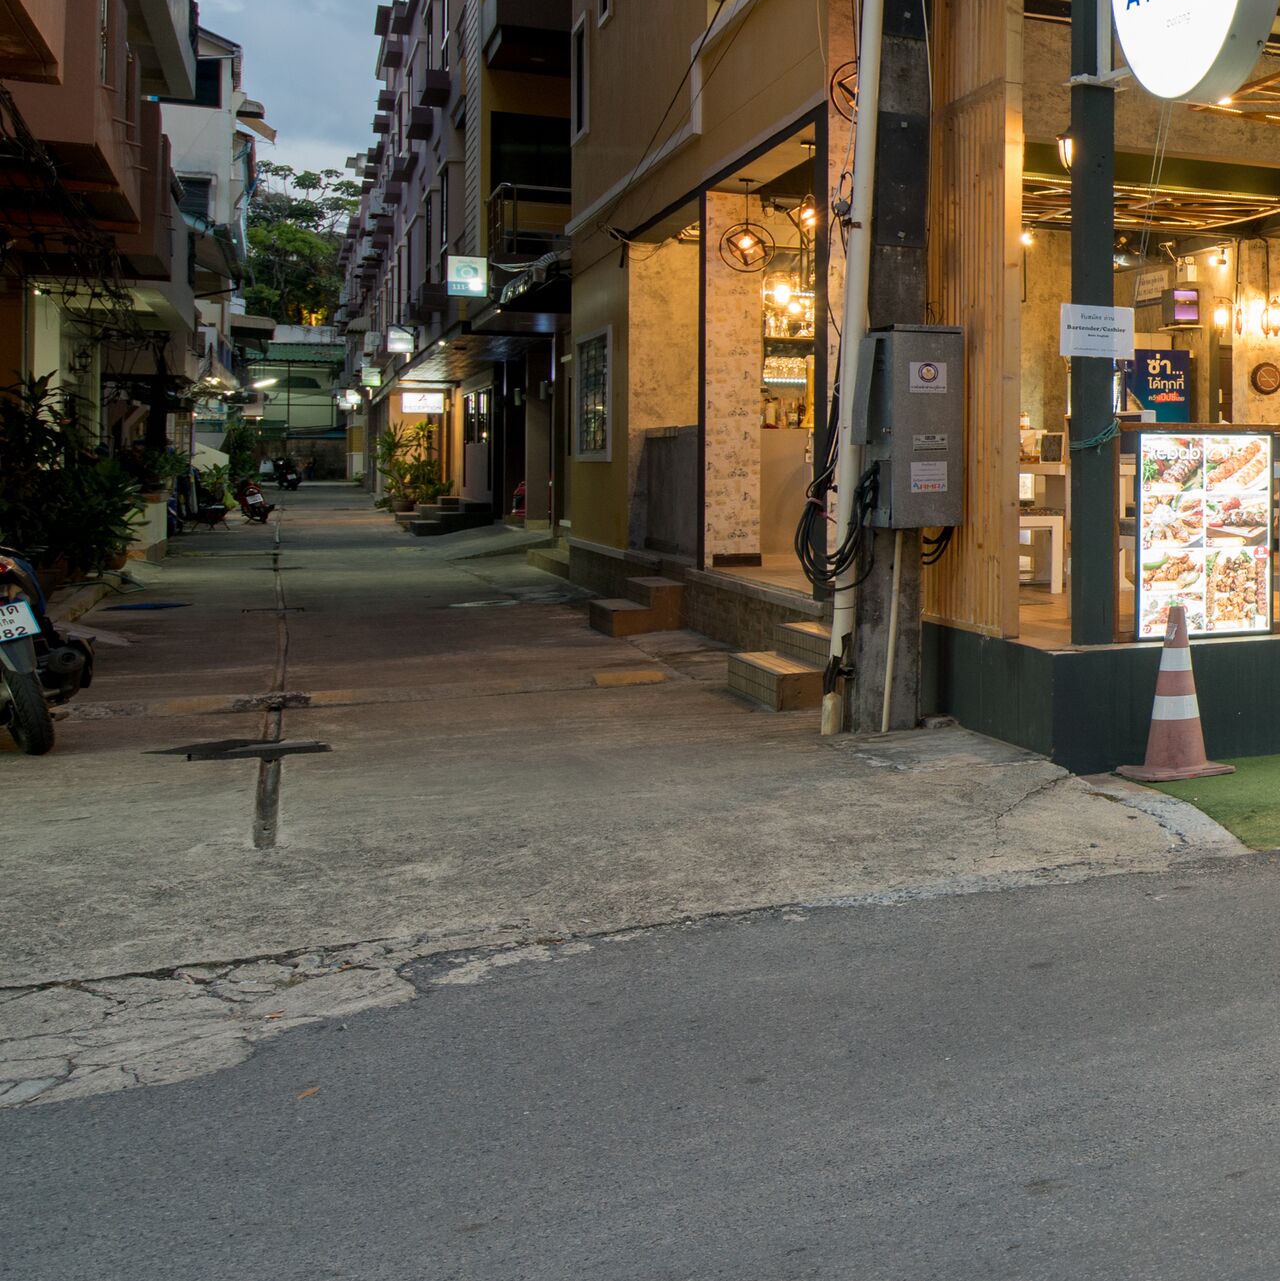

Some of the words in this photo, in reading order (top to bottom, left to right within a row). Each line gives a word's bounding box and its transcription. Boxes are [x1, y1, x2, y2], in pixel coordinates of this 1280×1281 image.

[1067, 324, 1126, 333] Bartender/Cashier
[1148, 376, 1185, 392] ได้ทุกที่
[1150, 444, 1201, 460] kebab
[0, 626, 28, 639] 82
